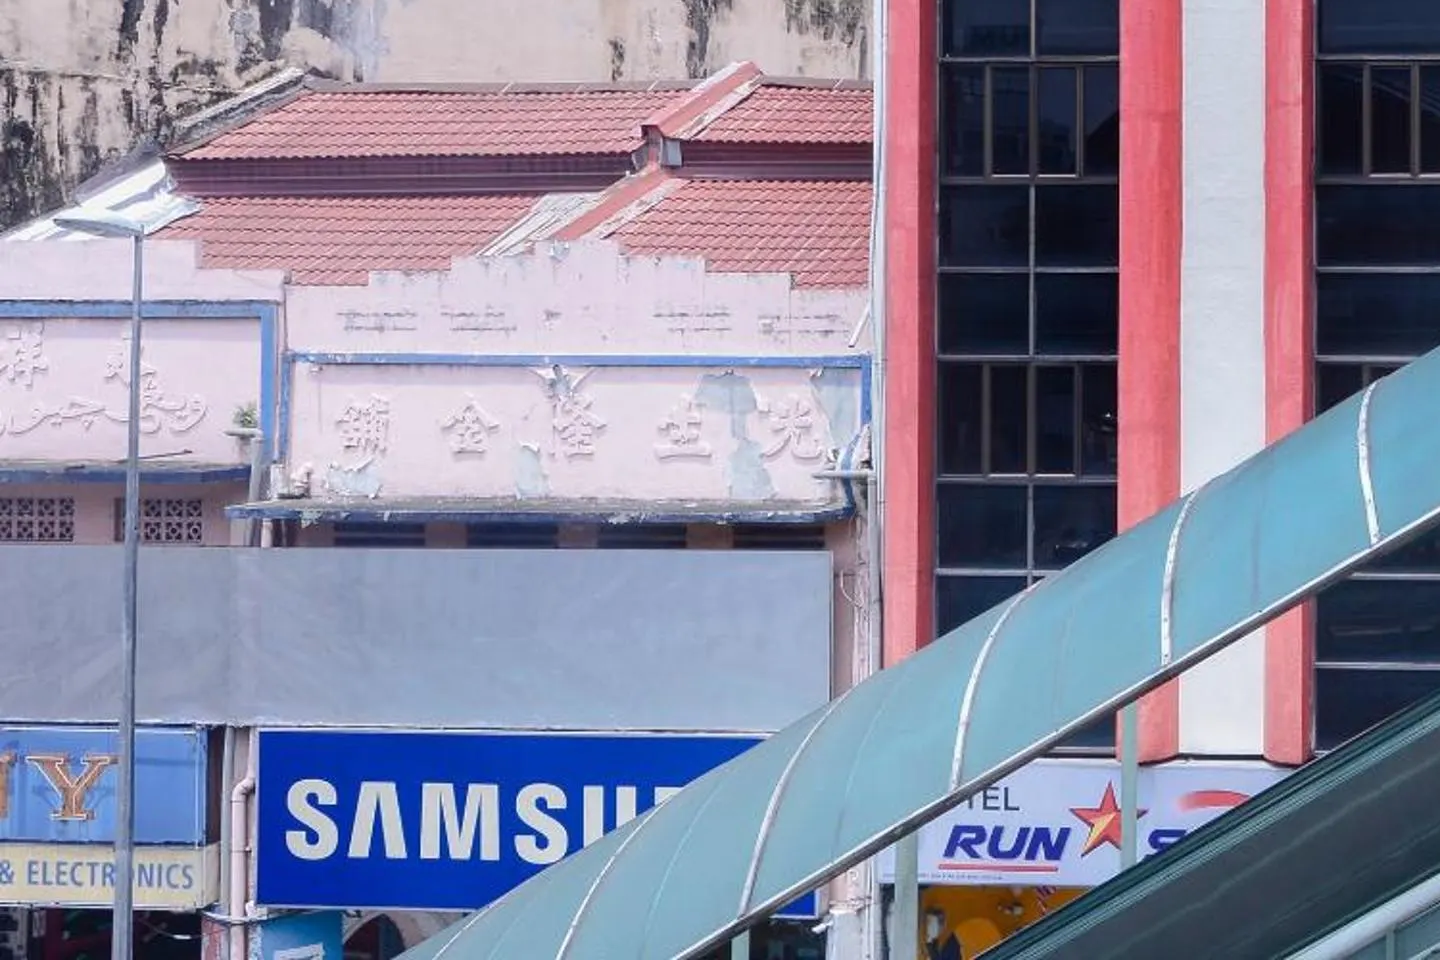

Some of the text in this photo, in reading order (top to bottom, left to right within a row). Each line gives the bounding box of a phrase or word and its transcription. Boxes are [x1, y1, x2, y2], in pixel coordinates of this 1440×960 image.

[285, 778, 684, 865] SAMSU
[942, 824, 1072, 862] RUN
[27, 860, 194, 890] ELECTRNICS
